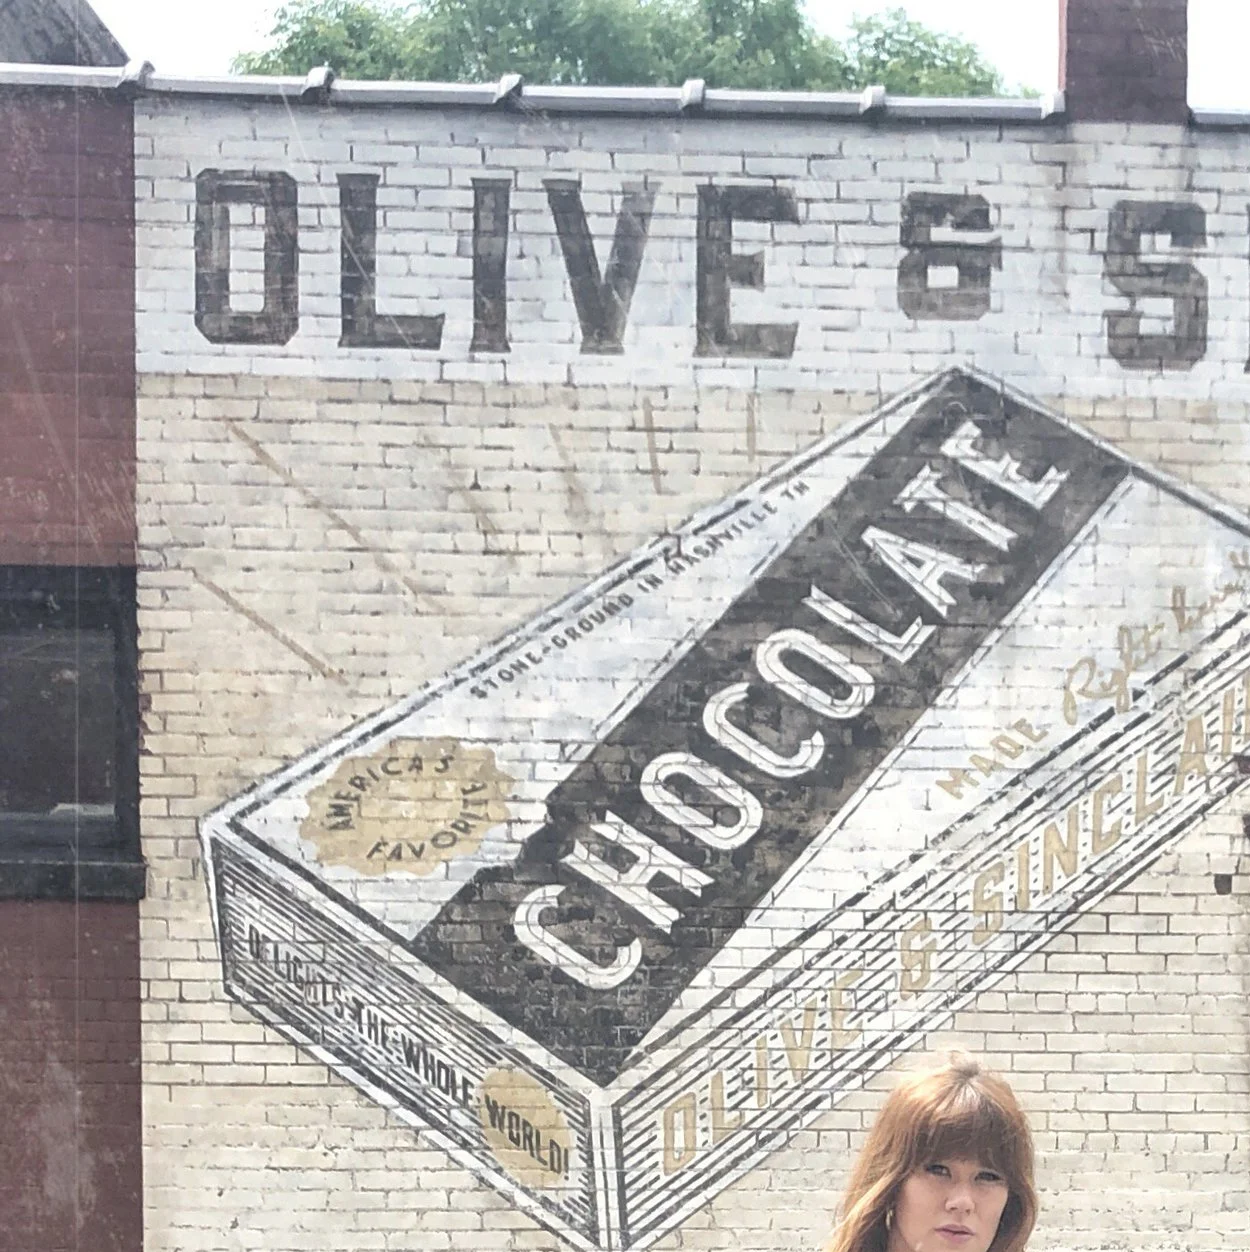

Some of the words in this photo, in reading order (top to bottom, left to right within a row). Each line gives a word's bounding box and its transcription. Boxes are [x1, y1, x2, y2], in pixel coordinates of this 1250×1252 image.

[195, 167, 799, 358] OLIVE
[898, 192, 1000, 320] &
[637, 574, 664, 593] IN
[667, 501, 778, 576] NASHVILLE
[513, 420, 1070, 991] CHOCOLATE
[934, 717, 1050, 801] MADE
[366, 781, 489, 861] FAVORITE
[663, 968, 865, 1176] OLIVE
[485, 1094, 570, 1181] WORLD!
